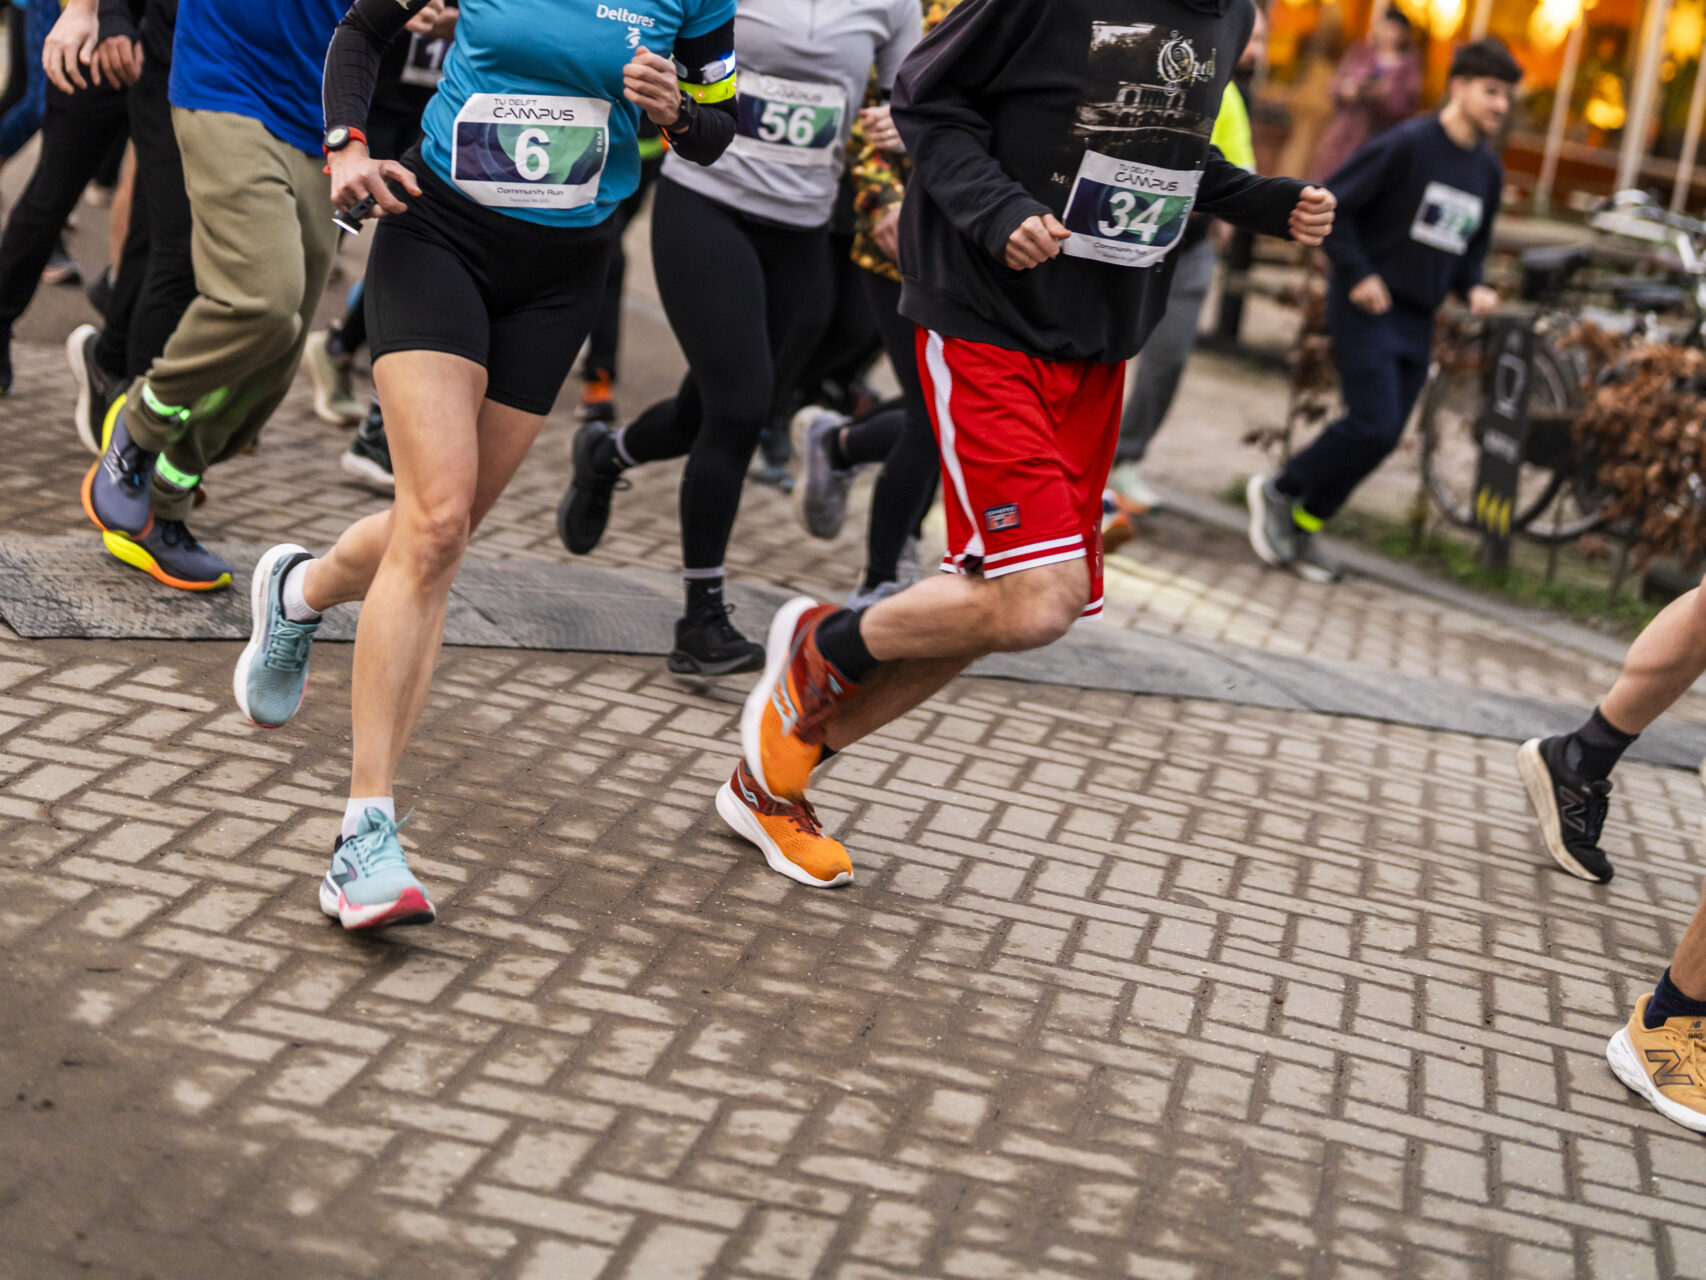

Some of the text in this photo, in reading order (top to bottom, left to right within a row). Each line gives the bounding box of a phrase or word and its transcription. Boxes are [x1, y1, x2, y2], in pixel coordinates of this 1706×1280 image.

[596, 4, 656, 28] Deltares
[493, 98, 506, 106] TU
[493, 107, 575, 121] CAMPUS
[757, 102, 817, 147] 56
[515, 128, 551, 181] 6
[496, 187, 546, 196] Community
[1114, 171, 1179, 192] CAMPUS
[1097, 191, 1168, 242] 34
